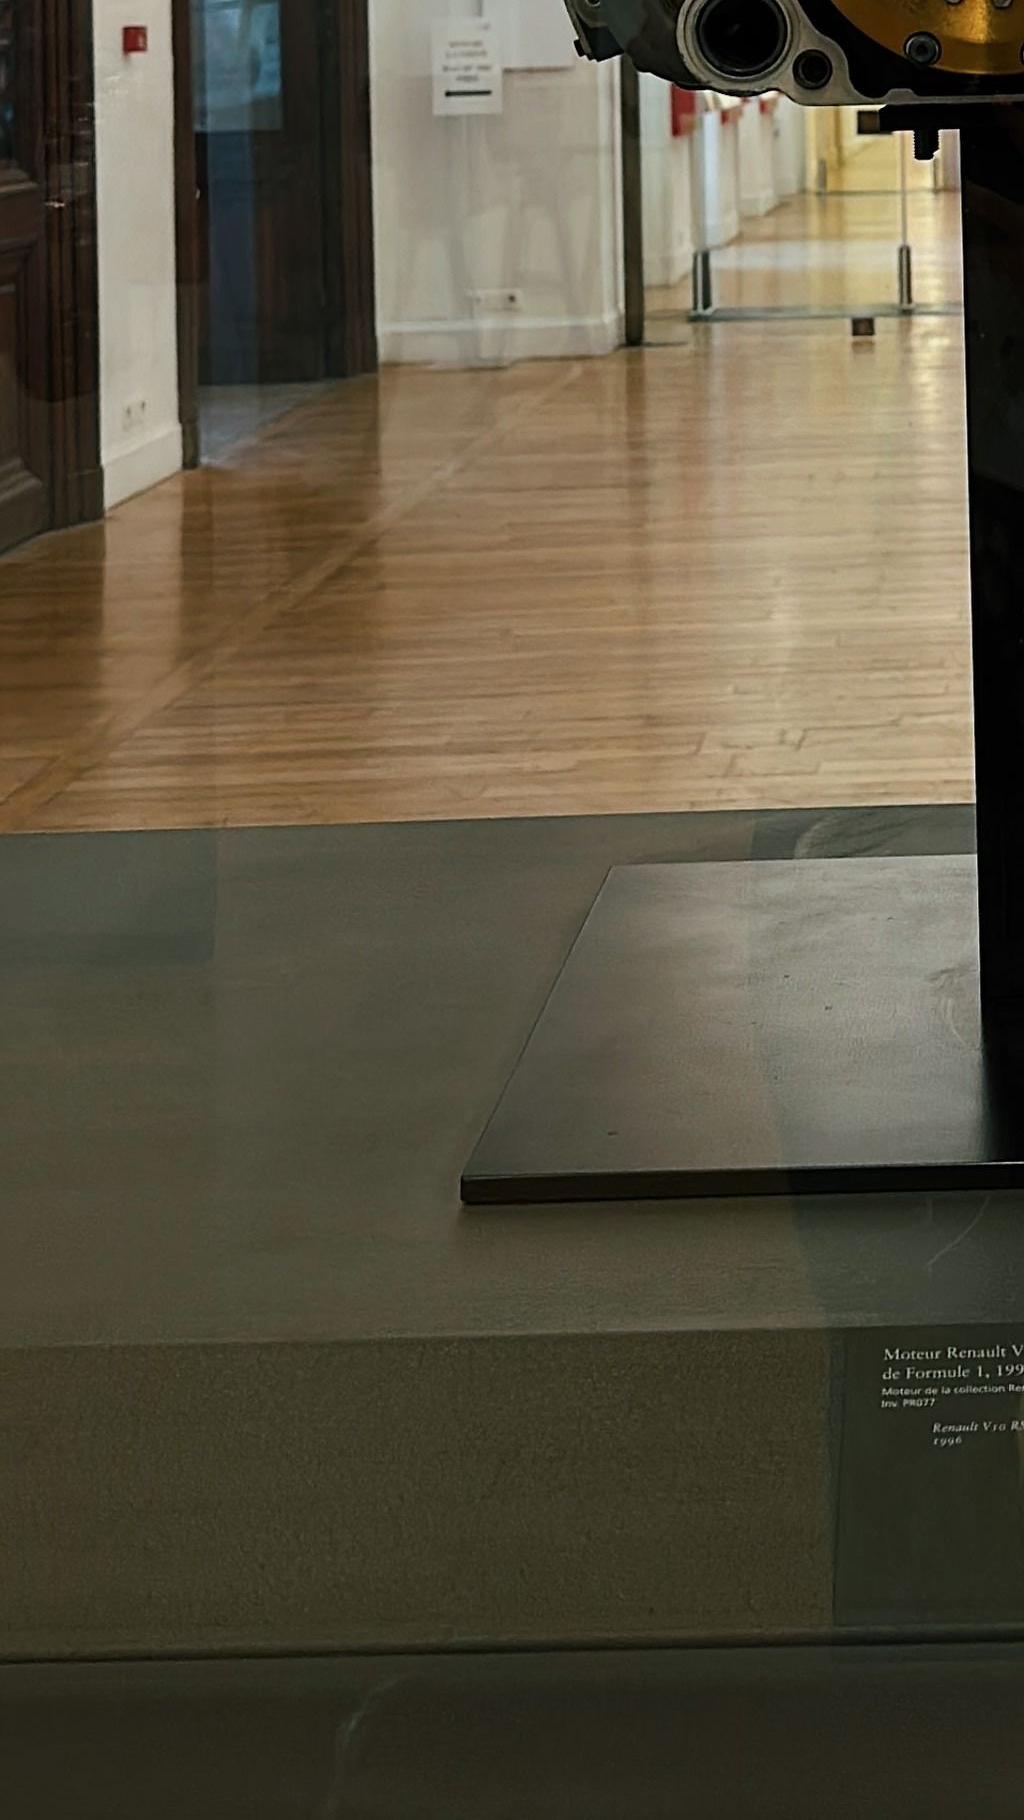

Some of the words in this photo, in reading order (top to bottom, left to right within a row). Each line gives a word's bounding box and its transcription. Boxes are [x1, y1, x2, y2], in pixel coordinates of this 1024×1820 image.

[883, 1347, 942, 1361] Moteur
[946, 1344, 1006, 1359] Renault
[882, 1366, 901, 1380] de
[905, 1364, 970, 1380] Formule
[881, 1387, 923, 1397] Moteur
[924, 1386, 939, 1395] de
[941, 1386, 951, 1395] la
[953, 1384, 1006, 1395] collection
[932, 1421, 978, 1434] Renault
[932, 1435, 963, 1445] 1996
